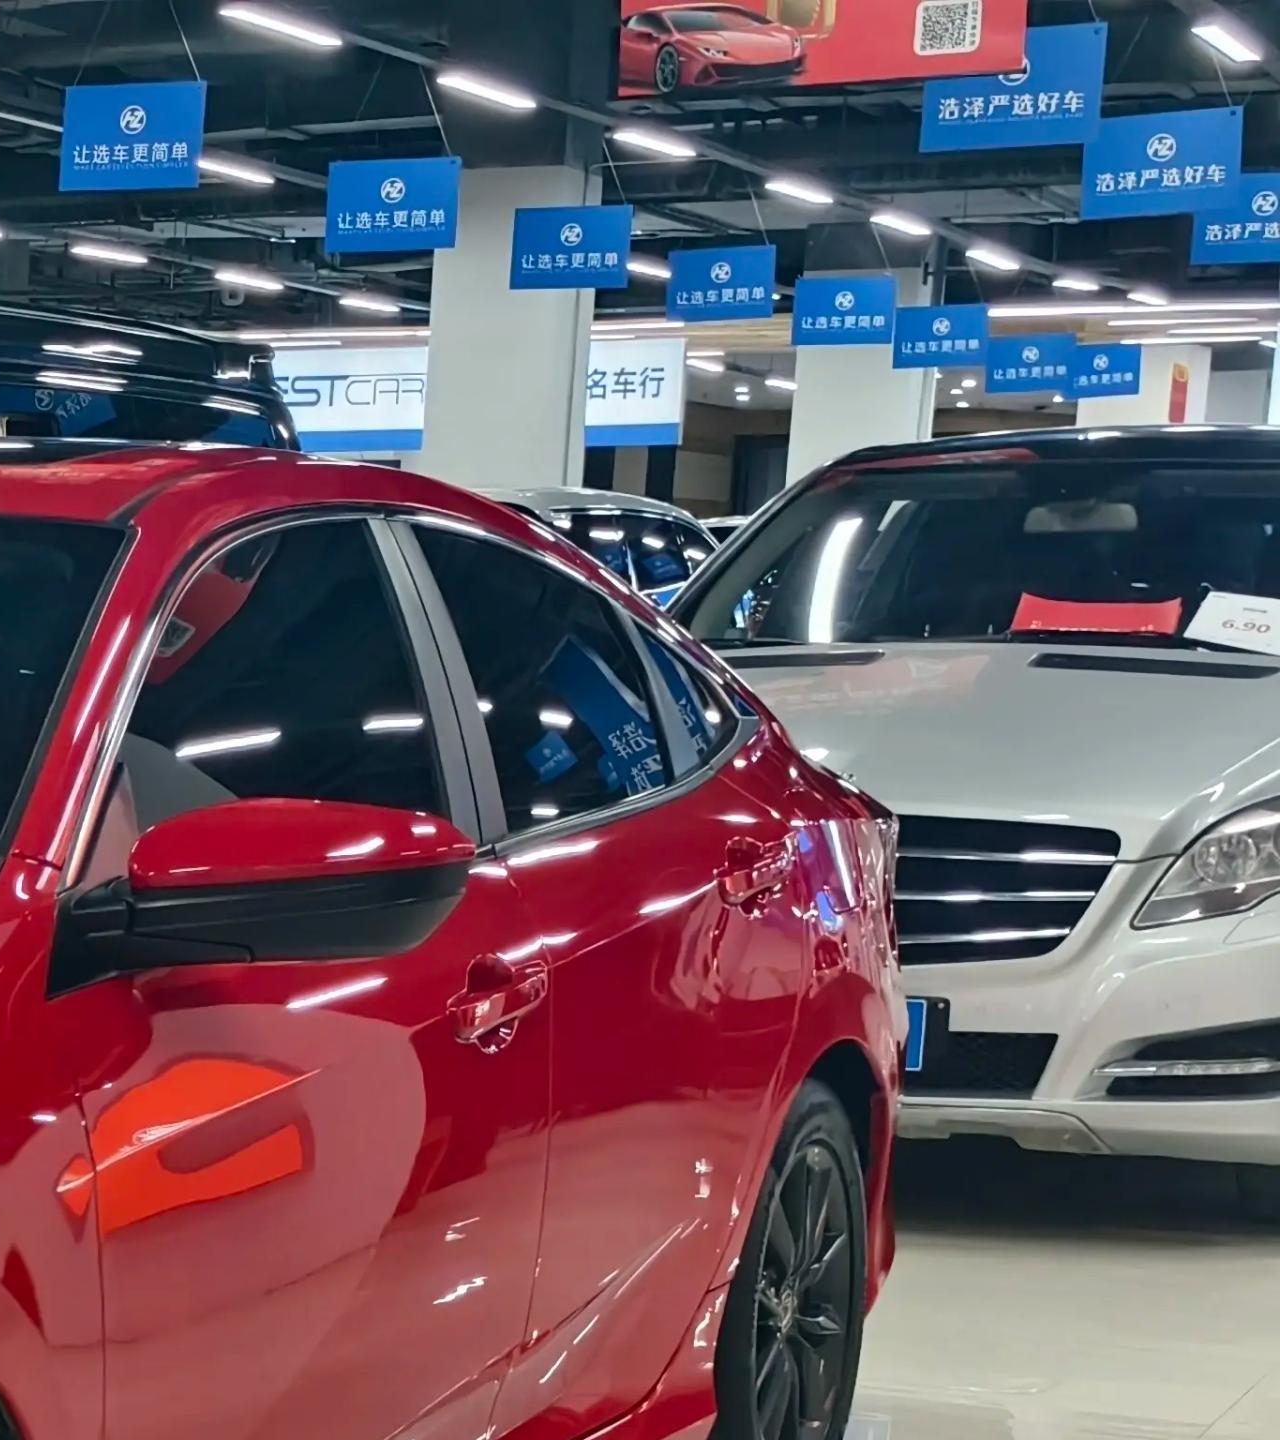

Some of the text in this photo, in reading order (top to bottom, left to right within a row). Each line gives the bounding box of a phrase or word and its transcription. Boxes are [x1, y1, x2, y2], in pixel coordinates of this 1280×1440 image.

[938, 91, 1085, 120] 浩泽严选好车
[73, 141, 188, 165] 让选车更简单
[1096, 164, 1226, 192] 浩泽严选好车
[337, 208, 446, 229] 让选车更简单
[521, 252, 618, 269] 让选车更简单
[676, 286, 765, 305] 让选车更简单
[801, 315, 885, 330] 让选车更简单
[587, 366, 665, 400] 名车行
[1221, 619, 1271, 634] 6.90
